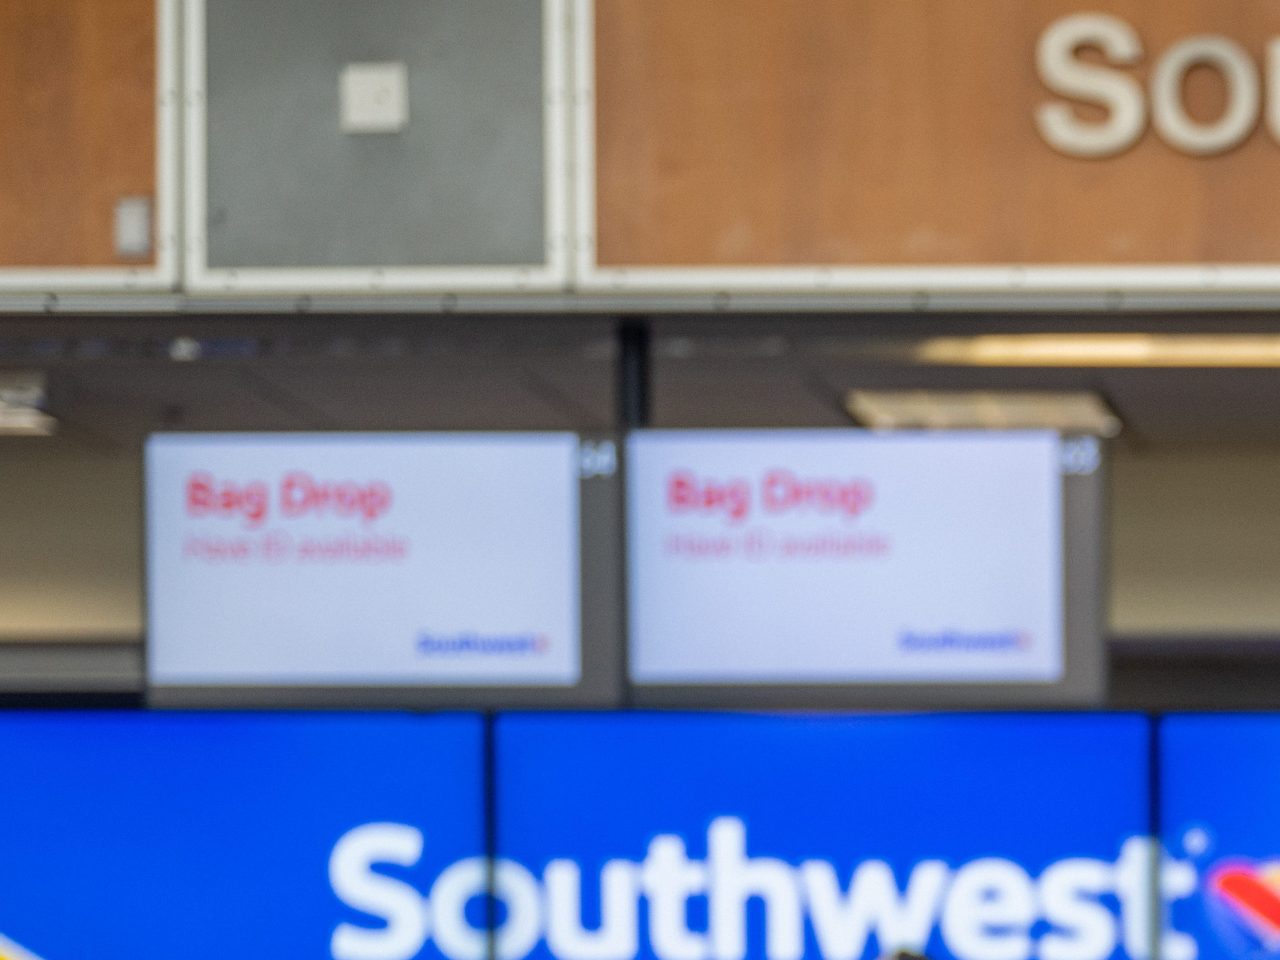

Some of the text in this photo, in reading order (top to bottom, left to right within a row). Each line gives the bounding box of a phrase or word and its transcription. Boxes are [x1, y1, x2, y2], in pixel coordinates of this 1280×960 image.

[187, 473, 392, 525] Bag Drop
[668, 471, 873, 522] Bag Drop
